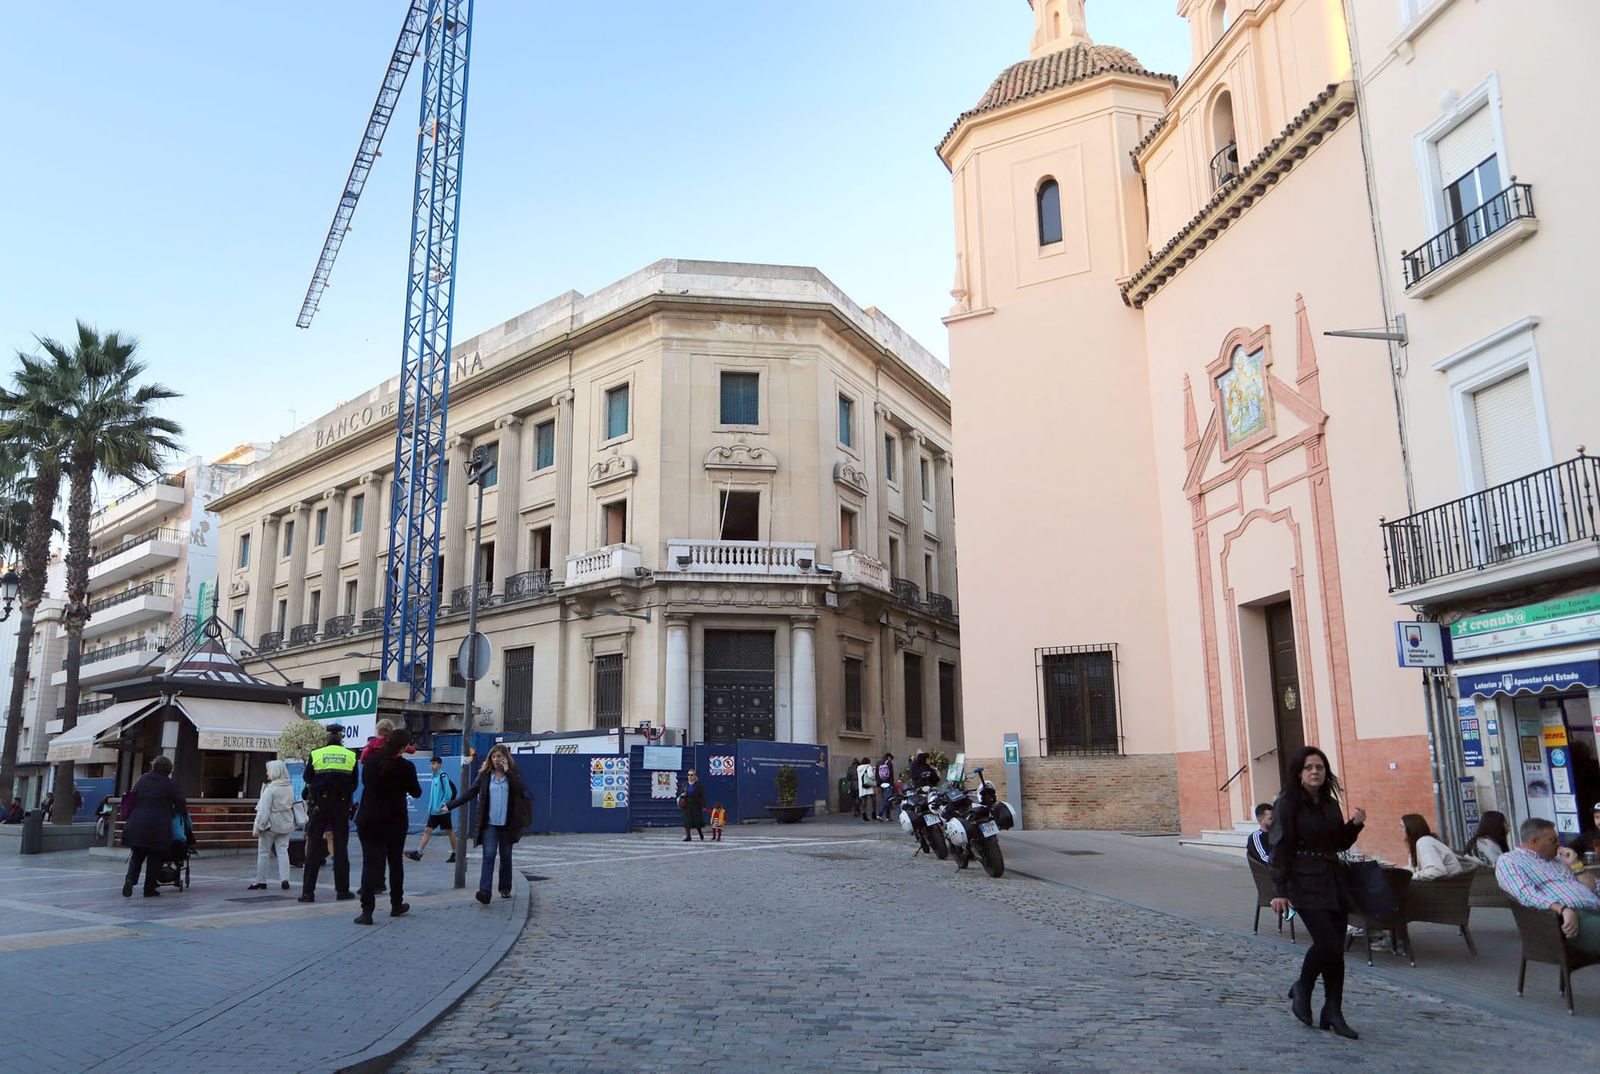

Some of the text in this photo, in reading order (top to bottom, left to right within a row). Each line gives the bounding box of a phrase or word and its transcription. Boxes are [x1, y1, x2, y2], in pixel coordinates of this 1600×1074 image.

[315, 401, 395, 449] BANCO DE
[1469, 610, 1526, 630] cronub@
[1514, 676, 1542, 685] Apuestas
[1543, 674, 1554, 682] del
[1555, 672, 1579, 681] Estado
[315, 687, 373, 714] SANDO
[223, 736, 254, 748] BURGUER
